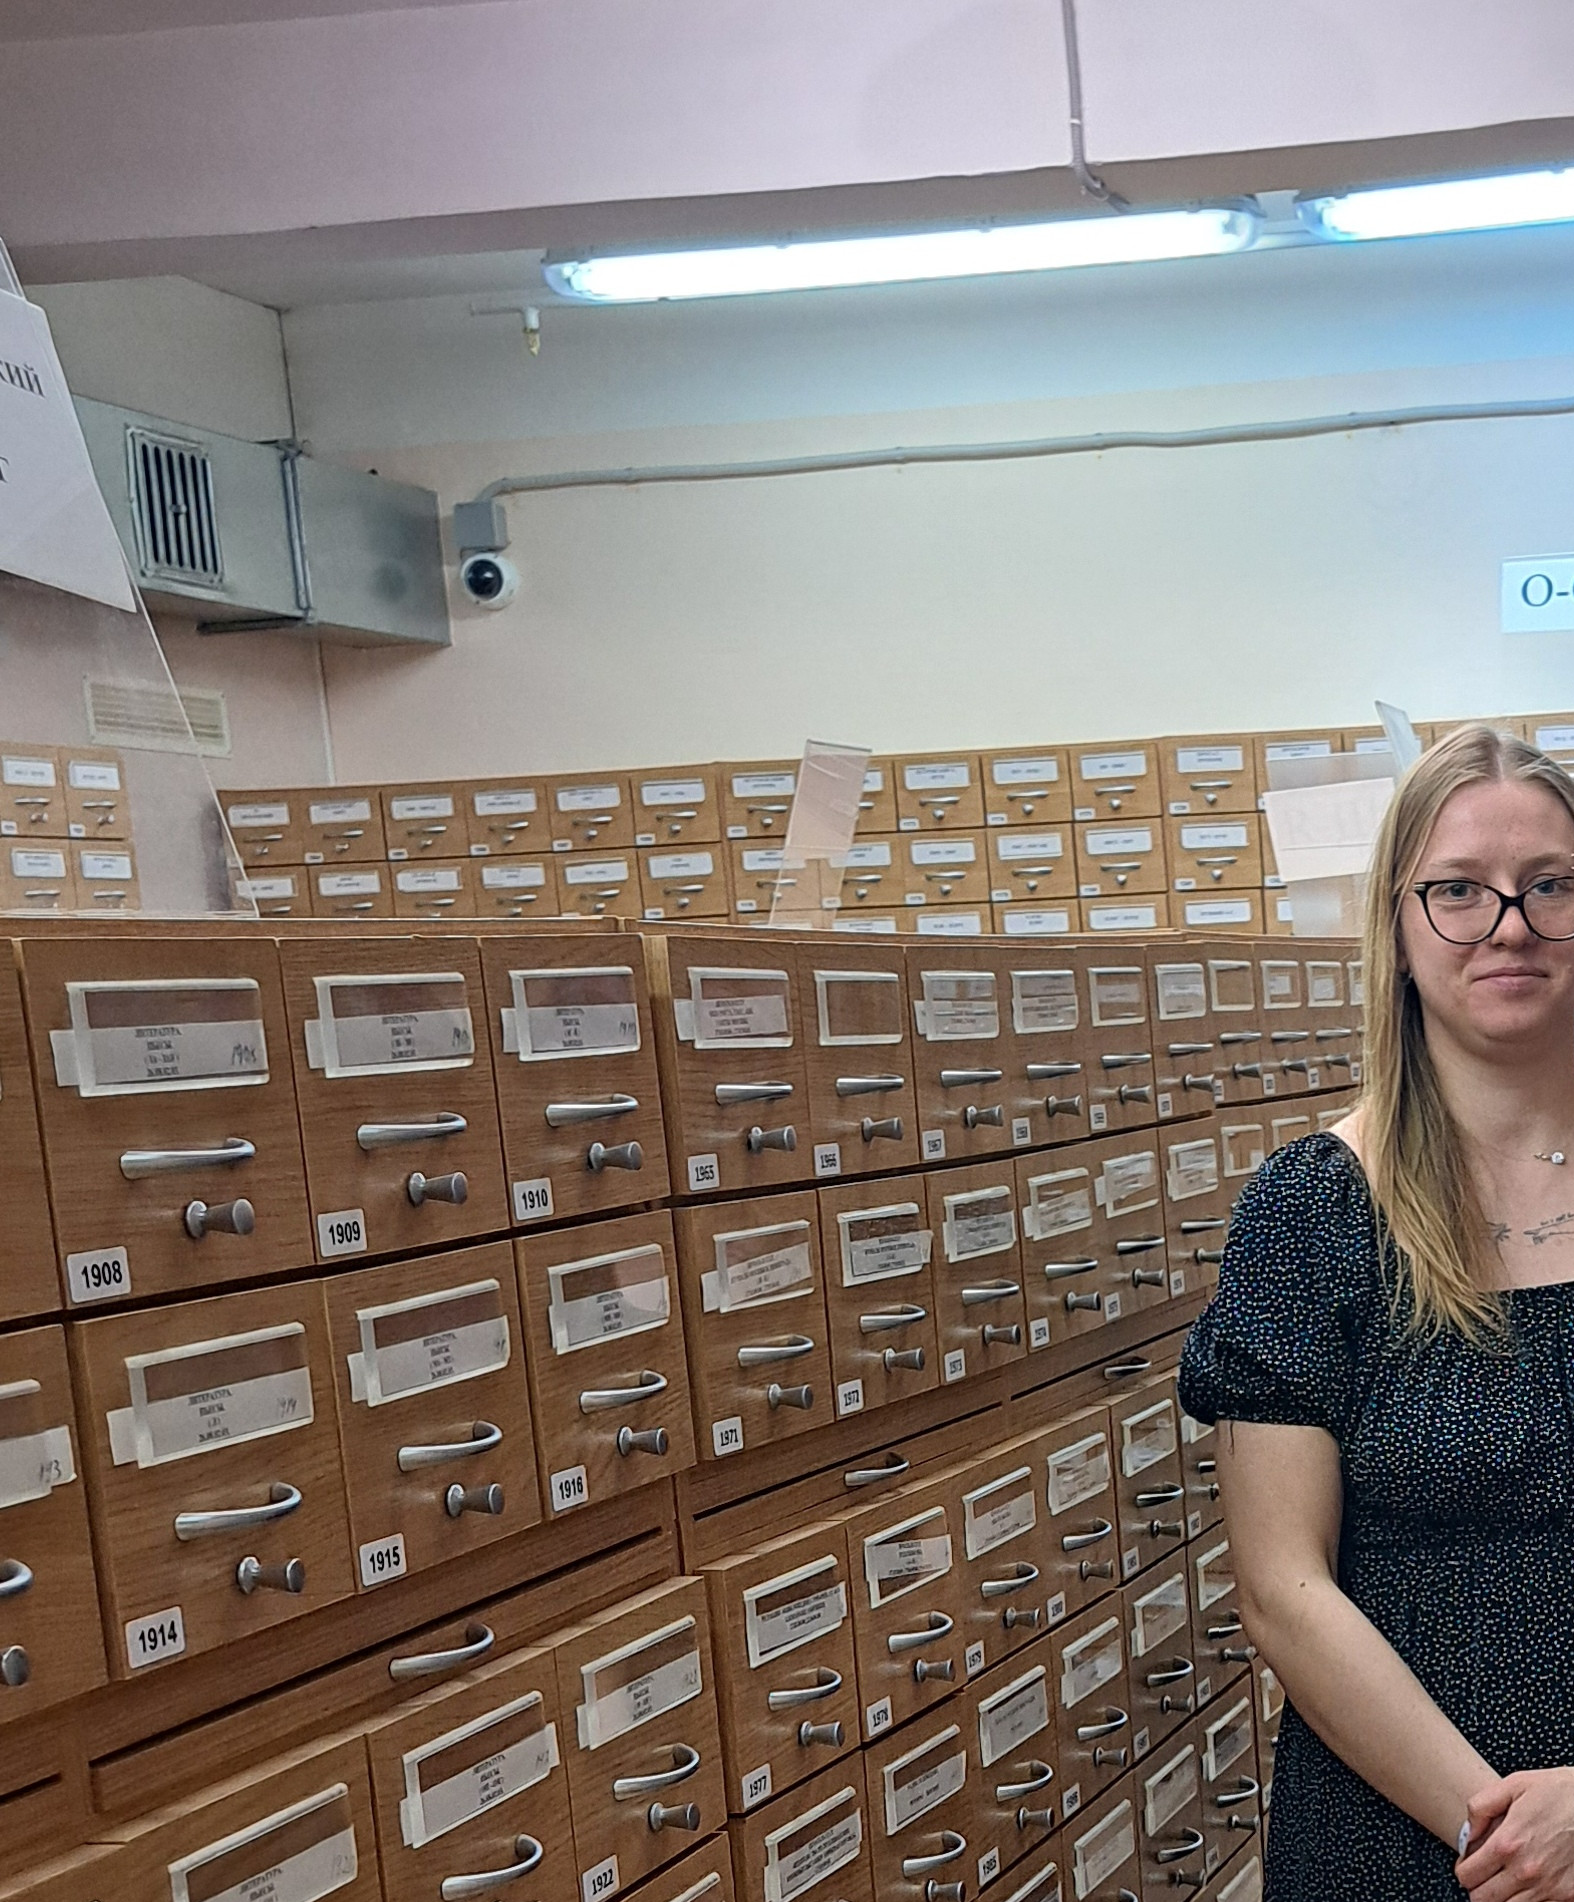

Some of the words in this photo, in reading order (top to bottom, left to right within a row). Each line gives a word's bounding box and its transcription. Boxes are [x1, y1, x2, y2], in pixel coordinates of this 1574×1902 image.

[522, 1189, 548, 1209] 1910
[329, 1221, 360, 1245] 1909
[81, 1260, 122, 1288] 1908
[720, 1428, 738, 1446] 1971
[559, 1476, 583, 1500] 1916
[370, 1546, 400, 1573] 1915
[139, 1620, 177, 1653] 1914
[750, 1775, 767, 1798] 1977
[592, 1869, 614, 1895] 1922
